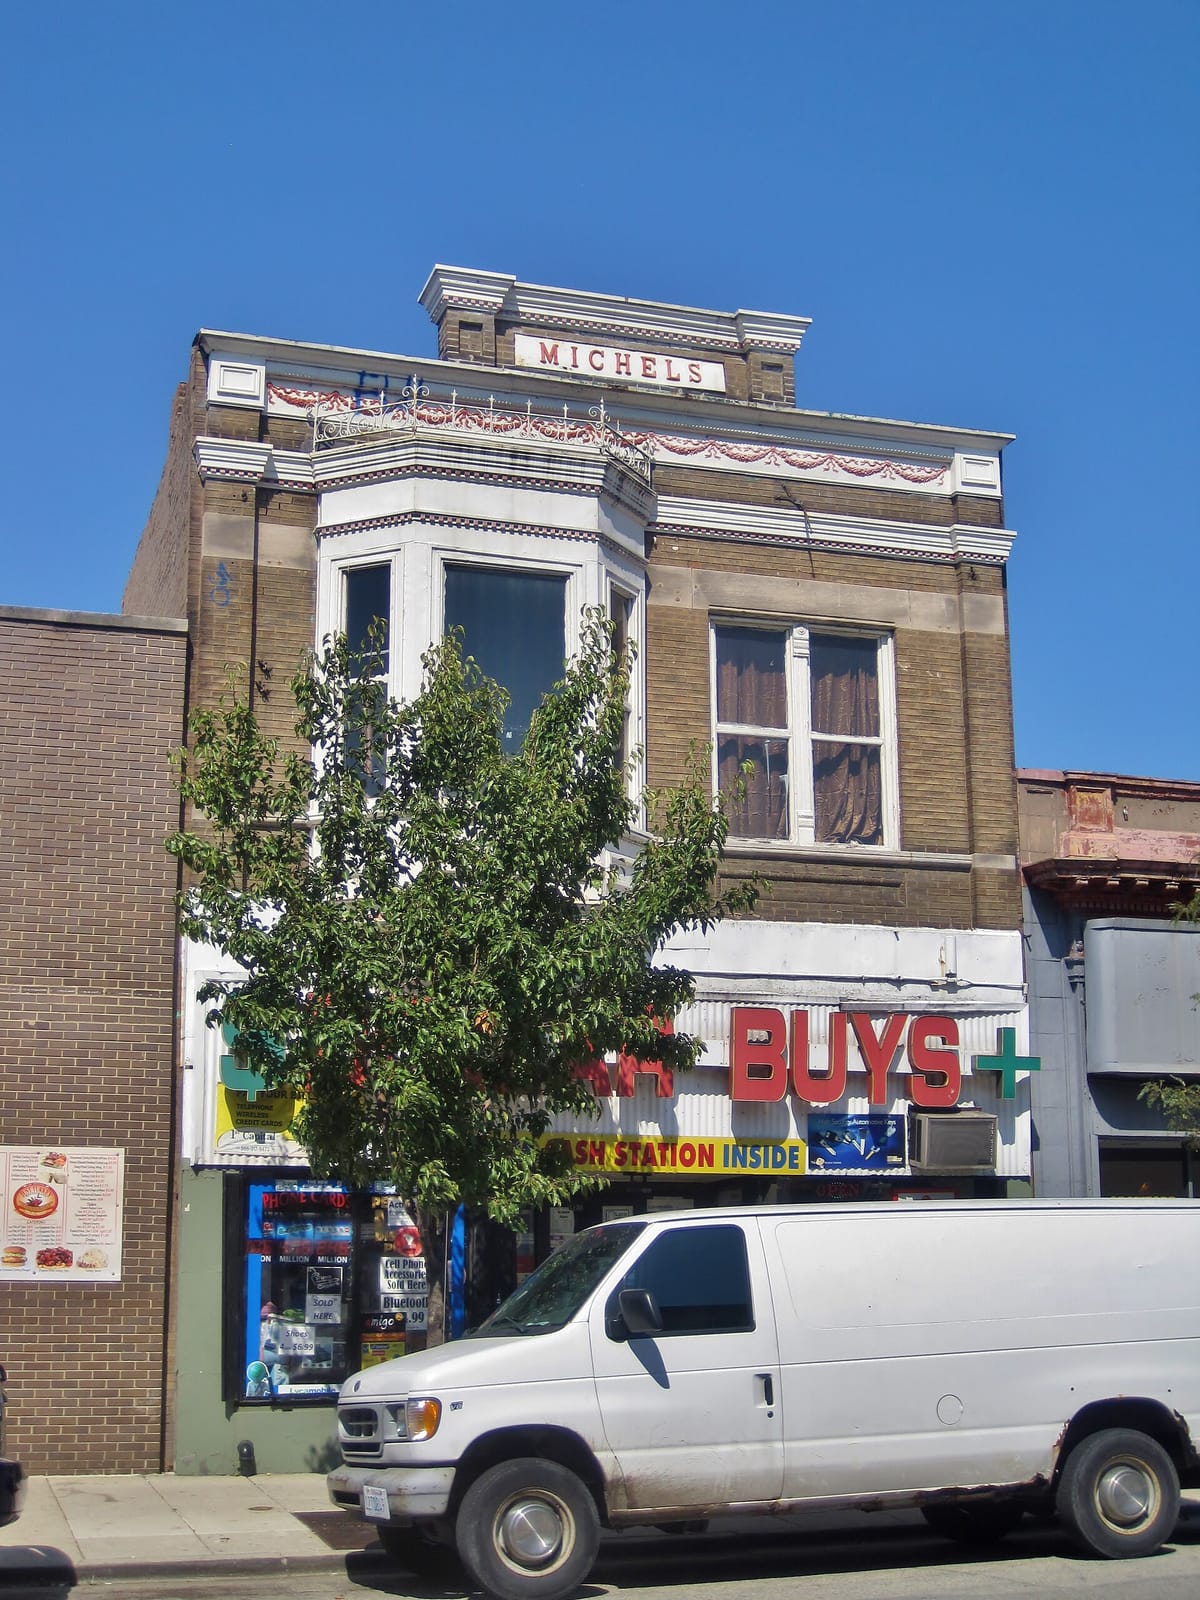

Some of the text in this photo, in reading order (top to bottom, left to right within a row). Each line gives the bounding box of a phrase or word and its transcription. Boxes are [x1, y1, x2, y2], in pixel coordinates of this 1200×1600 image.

[539, 341, 702, 383] MICHELS
[729, 1006, 962, 1108] BUYS
[236, 1103, 274, 1111] TELEPHONE
[236, 1118, 283, 1127] CREDIT CARDS
[242, 1131, 276, 1141] Capital
[614, 1140, 714, 1169] STATION
[723, 1143, 800, 1170] INSIDE
[279, 1255, 310, 1263] MILLION
[317, 1255, 348, 1264] MILLION
[385, 1259, 400, 1269] Cell
[384, 1270, 426, 1280] Accessorie
[387, 1280, 427, 1290] Sold Here
[312, 1299, 334, 1307] SOLD
[313, 1312, 334, 1320] HERE
[285, 1329, 309, 1338] Shoes
